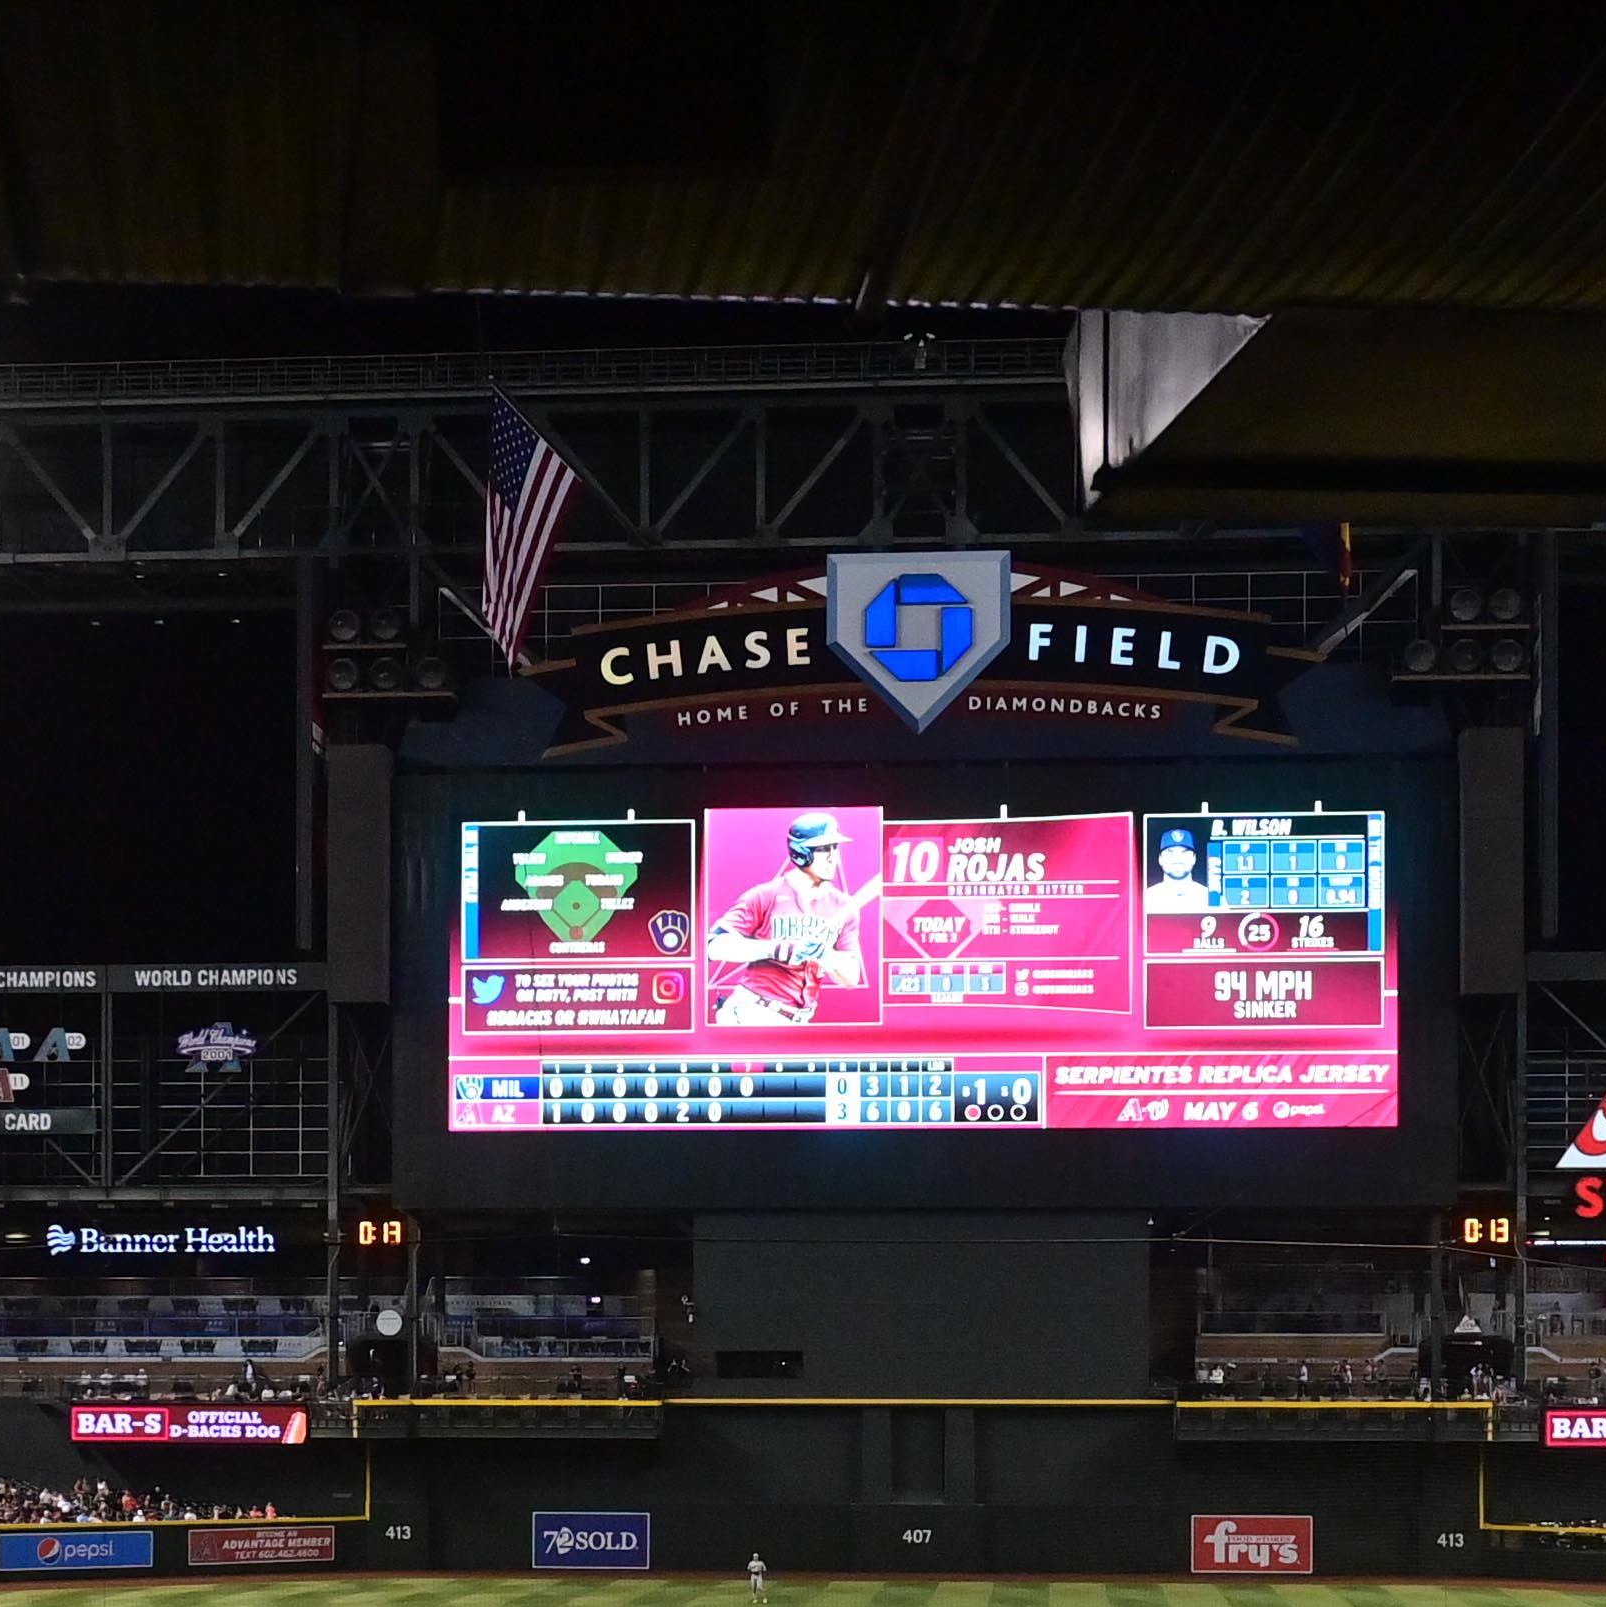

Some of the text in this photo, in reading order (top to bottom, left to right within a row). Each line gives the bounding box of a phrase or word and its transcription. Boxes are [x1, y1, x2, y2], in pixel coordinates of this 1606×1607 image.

[600, 623, 1241, 686] CHASE FIELD
[677, 695, 1163, 726] HOME OF THE DIAMONDBACKS
[1232, 819, 1292, 835] WILSON
[948, 837, 1001, 853] JOSH
[892, 841, 940, 883] 10
[947, 853, 1047, 882] ROJAS
[913, 917, 966, 933] TODAY
[1248, 925, 1270, 942] 25
[1299, 915, 1325, 937] 16
[135, 969, 297, 986] WORLD CHAMPIONS
[1214, 970, 1313, 1001] 94 MPH
[1233, 1001, 1297, 1019] SINKER
[12, 1036, 26, 1048] 01
[67, 1035, 82, 1048] 02
[201, 1049, 233, 1061] 2001
[13, 1076, 25, 1088] 11
[1055, 1064, 1390, 1084] SERPIENTES REPLICA JERSEY
[491, 1080, 524, 1098] MIL
[491, 1105, 516, 1123] AZ
[1184, 1102, 1237, 1121] MAY
[4, 1113, 51, 1131] CARD
[80, 1225, 276, 1253] Banner Health
[359, 1221, 401, 1245] 0:13
[1464, 1218, 1510, 1243] 0:13
[77, 1413, 162, 1435] BAR-S
[188, 1411, 262, 1424] OFFICIAL
[169, 1425, 281, 1438] D-BACKS DOG
[385, 1526, 412, 1541] 413
[901, 1529, 932, 1545] 407
[1438, 1532, 1465, 1549] 413
[64, 1539, 114, 1561] pepsi
[222, 1536, 331, 1550] ADVANTAGE MEMBER
[1204, 1520, 1300, 1566] fry's
